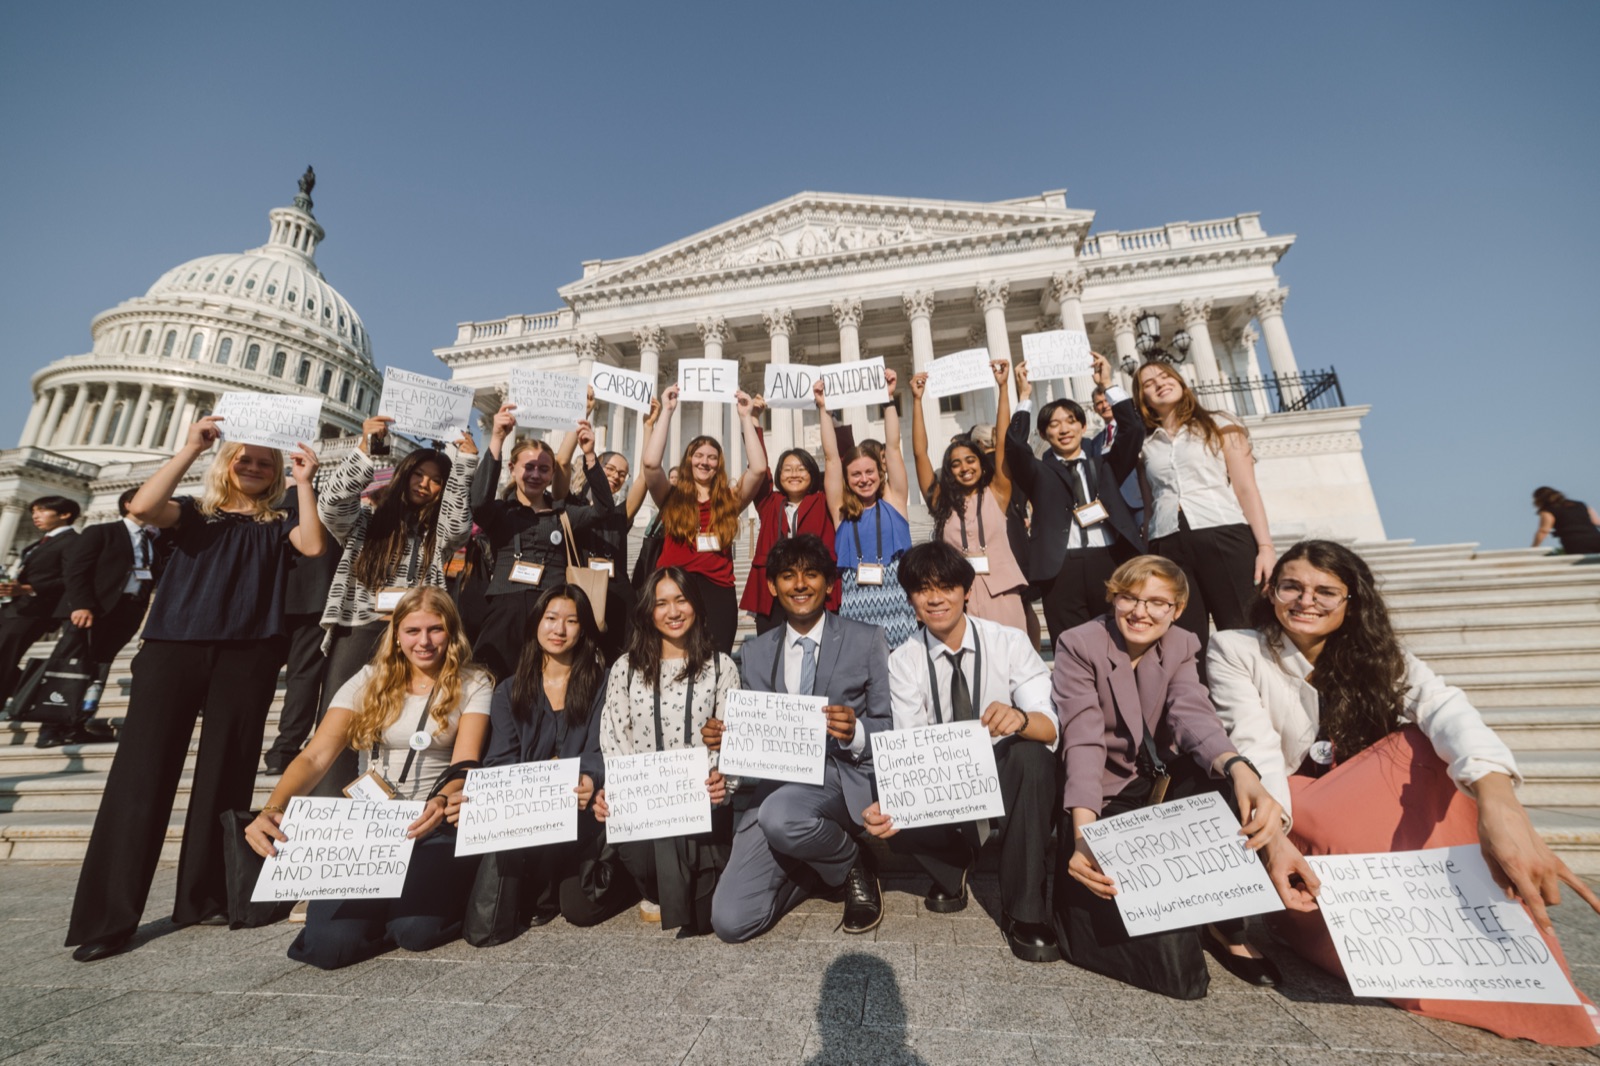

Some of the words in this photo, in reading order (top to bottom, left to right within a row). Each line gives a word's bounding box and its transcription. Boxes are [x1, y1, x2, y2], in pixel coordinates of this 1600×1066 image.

[1028, 350, 1055, 366] FEE
[1063, 346, 1088, 362] AND
[512, 368, 535, 378] Most
[543, 372, 580, 384] Effective
[512, 377, 545, 386] Climate
[684, 368, 724, 392] FEE
[770, 372, 811, 399] AND
[820, 364, 886, 396] DIVIDEND
[385, 388, 458, 410] #CARBON
[563, 390, 580, 400] FEE
[594, 372, 653, 404] CARBON
[385, 400, 415, 416] FEE
[424, 406, 454, 422] AND
[514, 396, 533, 407] AND
[536, 398, 584, 411] DIVIDEND
[291, 413, 317, 428] FEE
[729, 692, 759, 707] Most
[766, 694, 816, 713] Effective
[727, 708, 767, 720] Climate
[776, 710, 804, 725] Policy
[727, 721, 787, 739] #CARBON
[793, 727, 820, 741] FEE
[874, 733, 908, 752] Most
[913, 727, 972, 748] Effective
[726, 736, 754, 752] AND
[762, 739, 823, 758] DIVIDEND
[607, 758, 637, 770] Most
[643, 752, 695, 767] Effective
[878, 752, 925, 772] Climate
[933, 746, 972, 765] Policy
[470, 770, 503, 781] Most
[509, 763, 560, 778] Effective
[608, 771, 649, 785] Climate
[658, 765, 689, 778] Policy
[878, 766, 951, 791] #CARBON
[957, 762, 983, 780] FEE
[467, 780, 512, 793] Climate
[521, 775, 550, 785] Policy
[539, 783, 569, 798] FEE
[608, 782, 669, 802] #CARBON
[676, 778, 696, 791] FEE
[885, 790, 915, 809] AND
[924, 776, 998, 804] DIVIDEND
[288, 800, 340, 820] Most
[347, 800, 419, 821] Effective
[465, 808, 498, 826] AND
[504, 795, 577, 820] DIVIDEND
[613, 802, 638, 817] AND
[647, 791, 706, 811] DIVIDEND
[1083, 824, 1109, 840] Most
[1109, 812, 1152, 832] Effective
[1152, 803, 1185, 819] Climate
[1187, 796, 1217, 809] Policy
[283, 822, 354, 842] Climate
[366, 822, 409, 842] Policy
[1097, 827, 1191, 867] #CARBON
[1188, 817, 1230, 845] FEE
[274, 845, 364, 863] #CARBON
[369, 844, 400, 860] FEE
[271, 865, 312, 881] AND
[320, 861, 406, 880] DIVIDEND
[1116, 863, 1162, 894] AND
[1163, 840, 1256, 883] DIVIDEND
[1309, 860, 1361, 882] Most
[1363, 857, 1462, 880] Effective
[1320, 884, 1393, 906] Climate
[1403, 881, 1469, 906] Policy
[1330, 906, 1455, 936] #CARBON
[1455, 904, 1515, 934] FEE
[1344, 934, 1403, 966] AND
[1409, 935, 1549, 967] DIVIDEND
